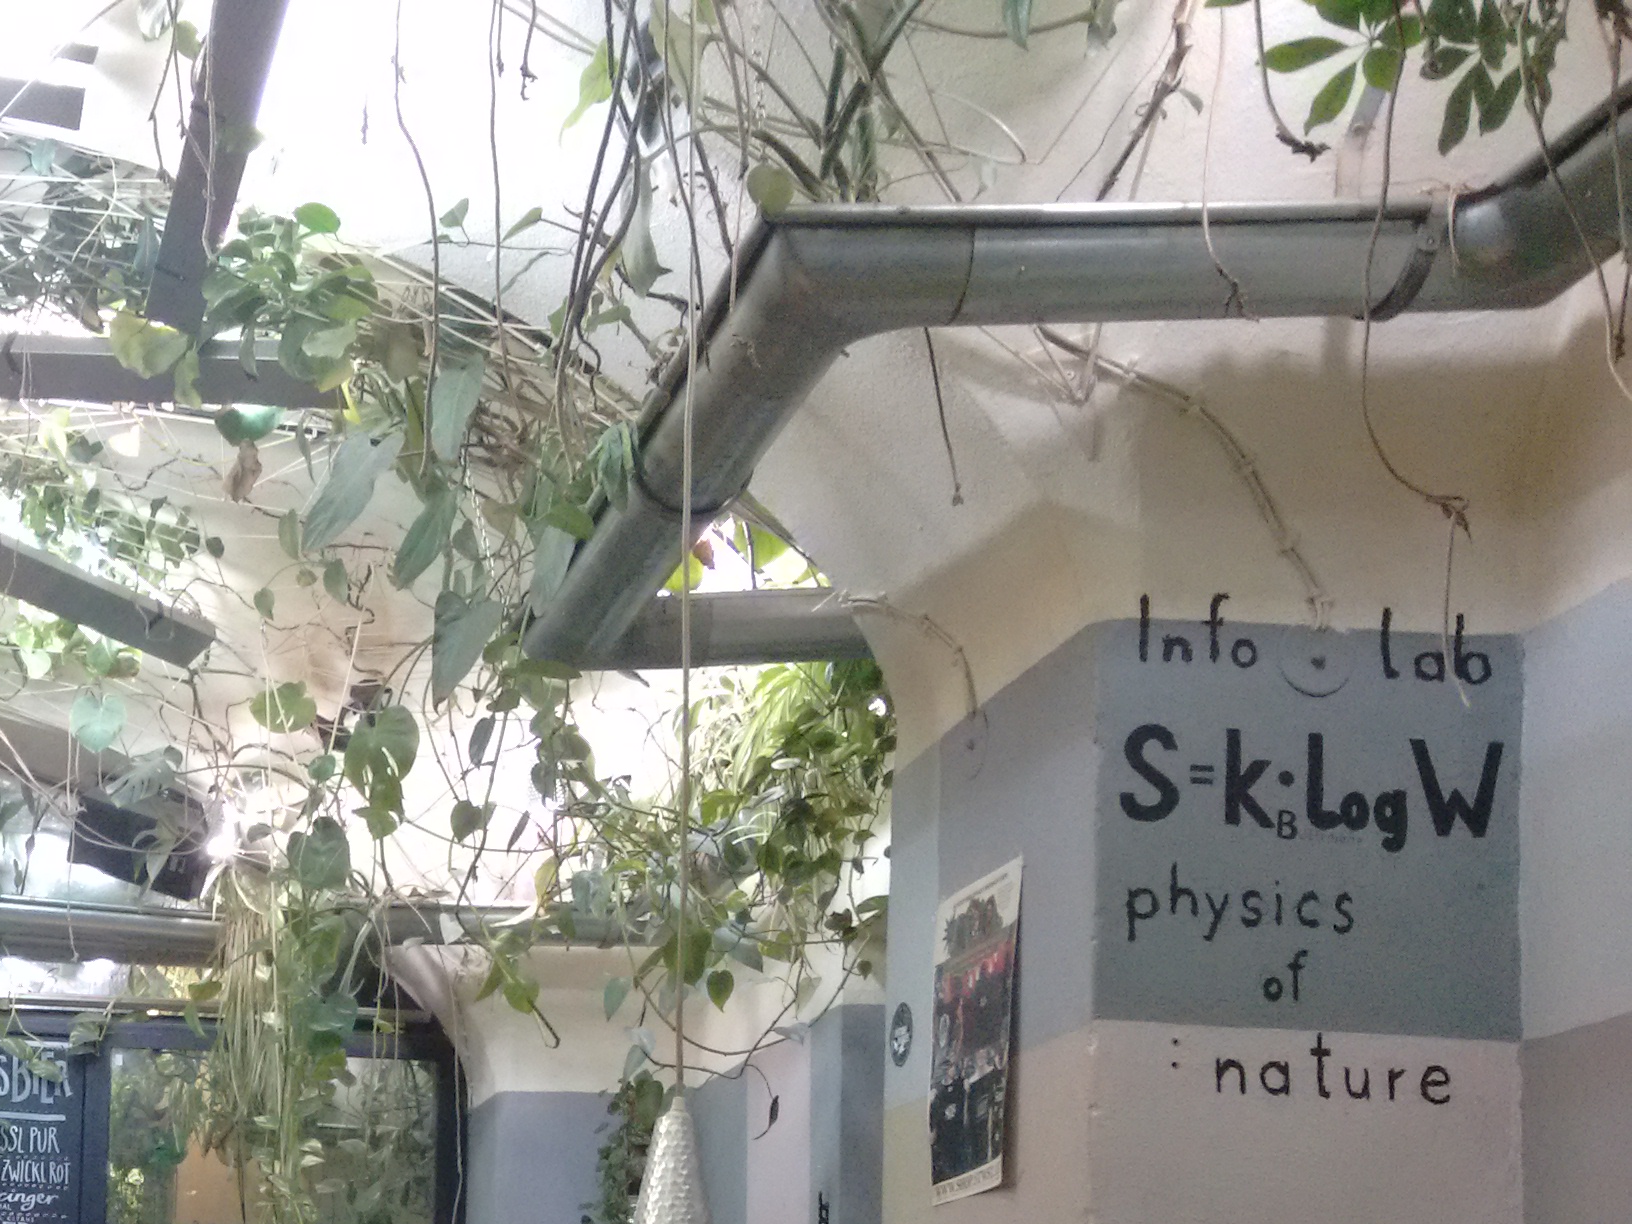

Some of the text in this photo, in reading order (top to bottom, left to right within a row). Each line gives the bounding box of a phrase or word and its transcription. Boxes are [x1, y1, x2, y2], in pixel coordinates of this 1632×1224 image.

[1138, 593, 1493, 686] Info lab
[1125, 861, 1355, 942] physics
[1262, 950, 1308, 1002] of
[1215, 1033, 1452, 1105] nature
[29, 1126, 61, 1154] PUR
[0, 1158, 47, 1184] ZWICKL
[48, 1161, 72, 1185] ROT
